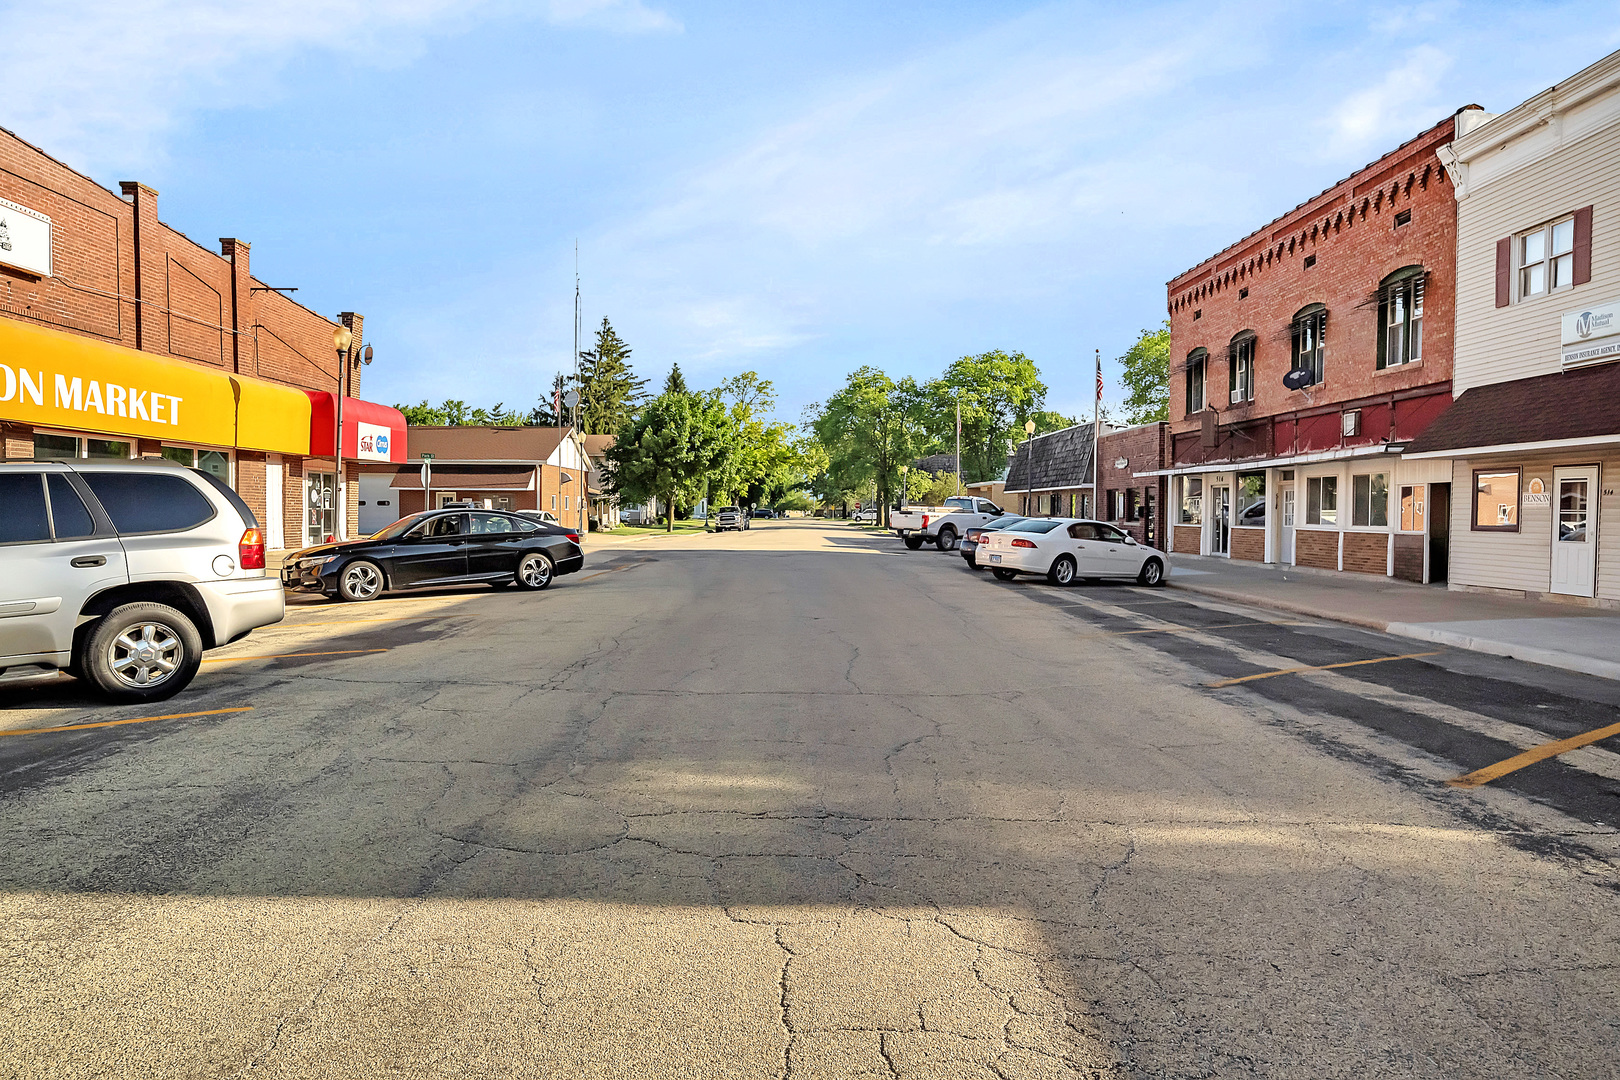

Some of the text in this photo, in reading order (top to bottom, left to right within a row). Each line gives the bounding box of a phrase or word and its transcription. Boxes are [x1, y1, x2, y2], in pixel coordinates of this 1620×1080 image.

[55, 374, 183, 426] MARKET
[361, 440, 374, 453] STAR
[1523, 494, 1549, 502] BENSON
